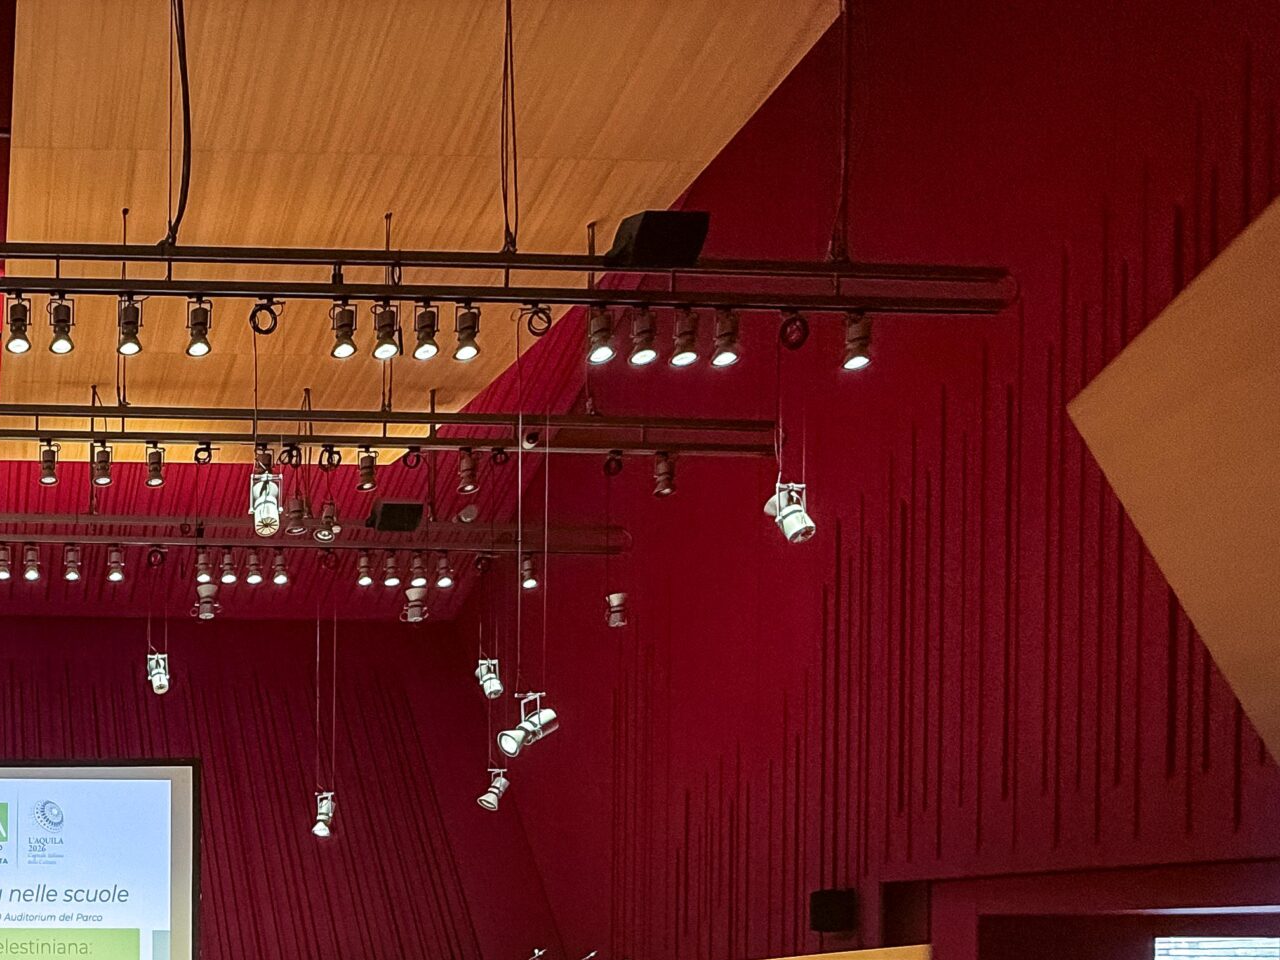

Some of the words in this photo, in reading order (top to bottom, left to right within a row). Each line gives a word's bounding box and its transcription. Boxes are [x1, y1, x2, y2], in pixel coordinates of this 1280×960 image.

[28, 837, 64, 846] L'AQUILA
[9, 884, 58, 902] nelle
[62, 884, 129, 902] scuole
[4, 913, 56, 922] Auditorium
[58, 913, 73, 922] del
[76, 914, 102, 922] Parco
